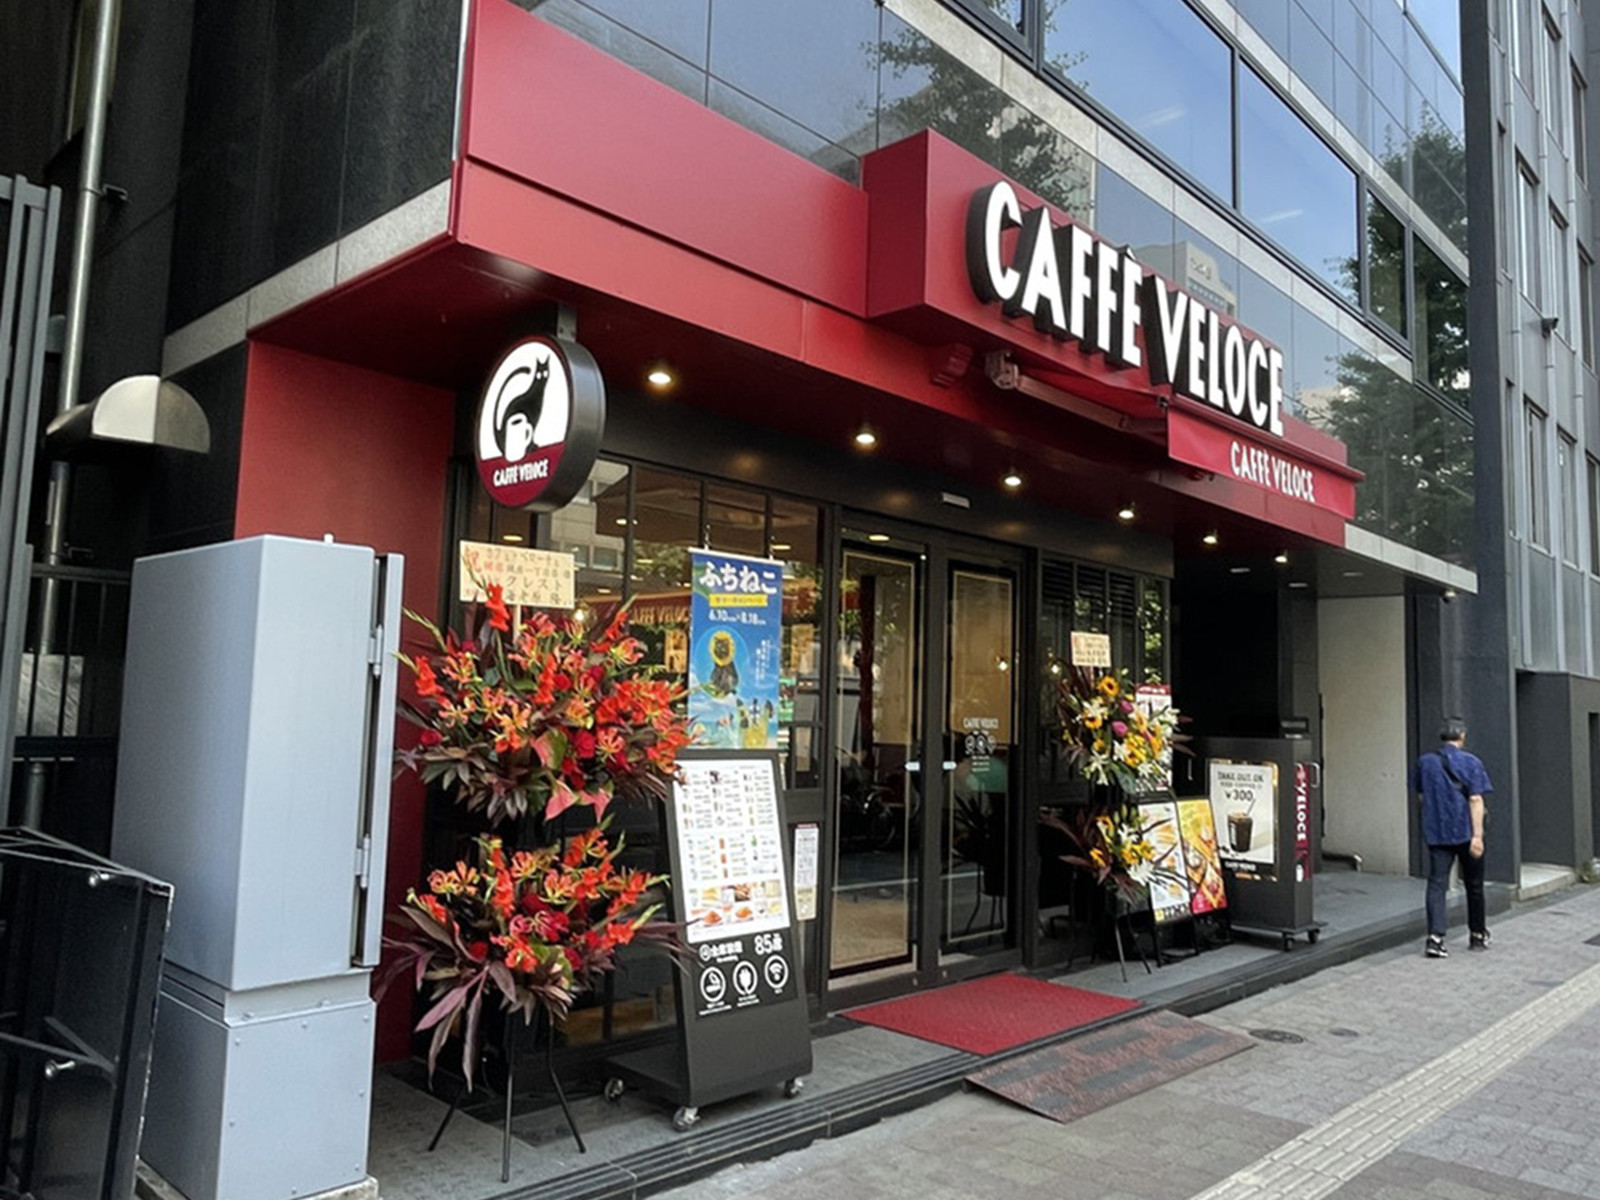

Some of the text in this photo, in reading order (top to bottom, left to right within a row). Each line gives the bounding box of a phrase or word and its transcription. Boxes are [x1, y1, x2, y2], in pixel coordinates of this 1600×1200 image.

[984, 181, 1284, 436] CAFFÈ VELOCE
[519, 459, 549, 483] VELOCE
[1271, 455, 1315, 503] VELOCE
[506, 575, 562, 591] クレスト
[699, 560, 777, 595] ふちねこ
[1237, 773, 1252, 782] OUT
